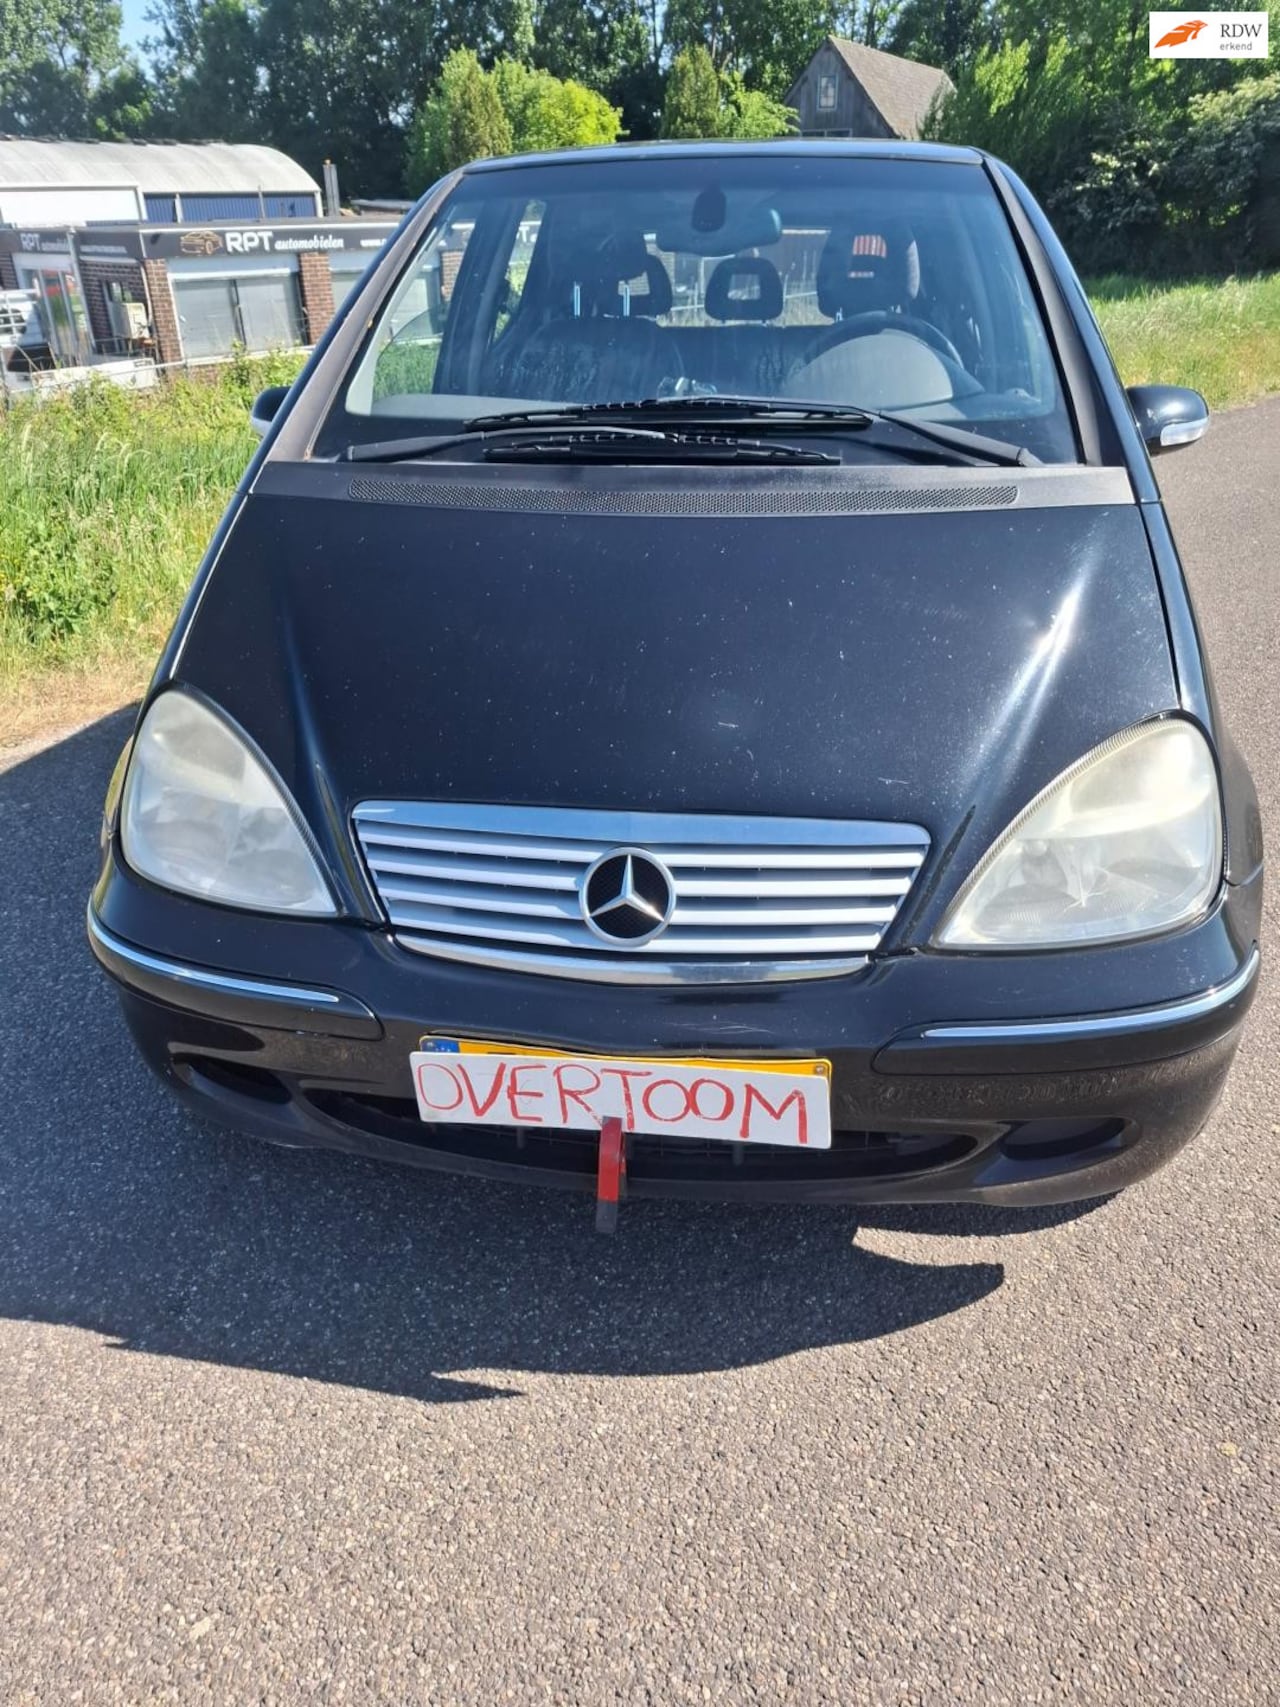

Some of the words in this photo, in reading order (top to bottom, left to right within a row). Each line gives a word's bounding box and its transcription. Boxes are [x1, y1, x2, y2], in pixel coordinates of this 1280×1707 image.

[225, 230, 274, 252] RPT
[274, 235, 344, 250] automobielen
[417, 1062, 808, 1144] OVERTOOM
